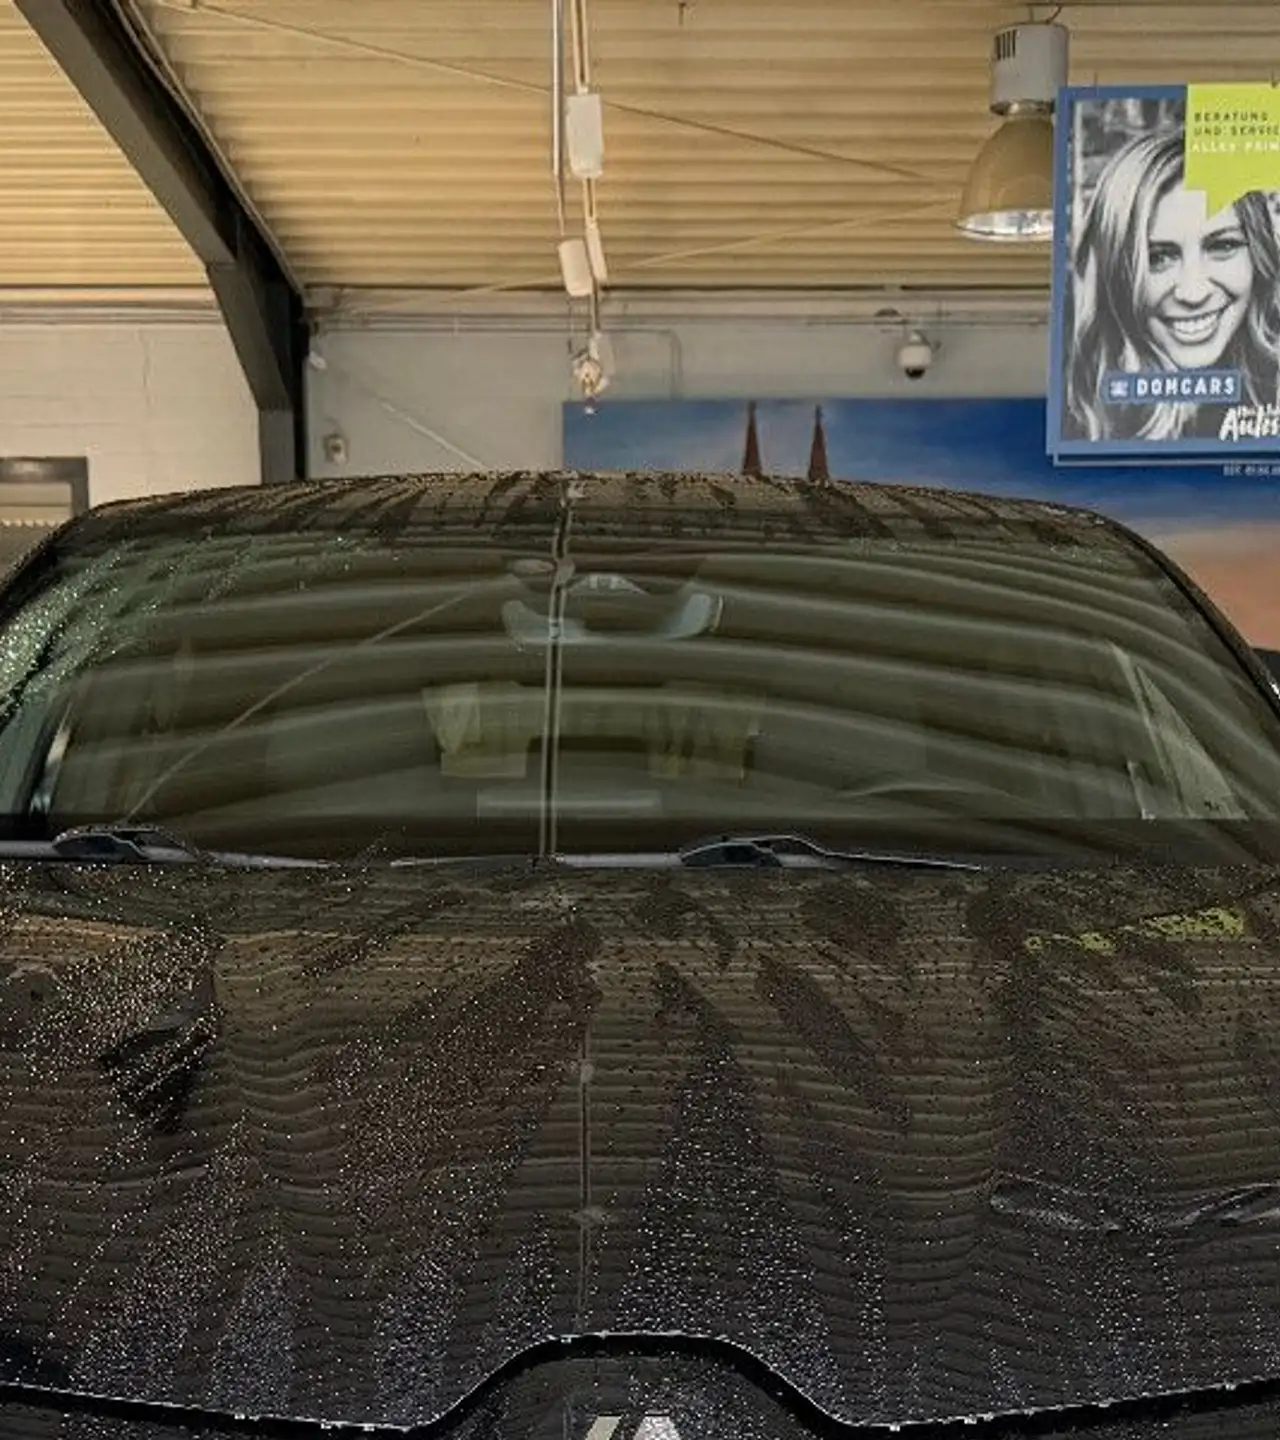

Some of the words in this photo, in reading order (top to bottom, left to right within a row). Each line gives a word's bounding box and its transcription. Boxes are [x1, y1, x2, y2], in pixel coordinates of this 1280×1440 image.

[1193, 111, 1268, 122] BERATUNG
[1193, 125, 1222, 136] UND
[1136, 376, 1235, 396] DOMCARS
